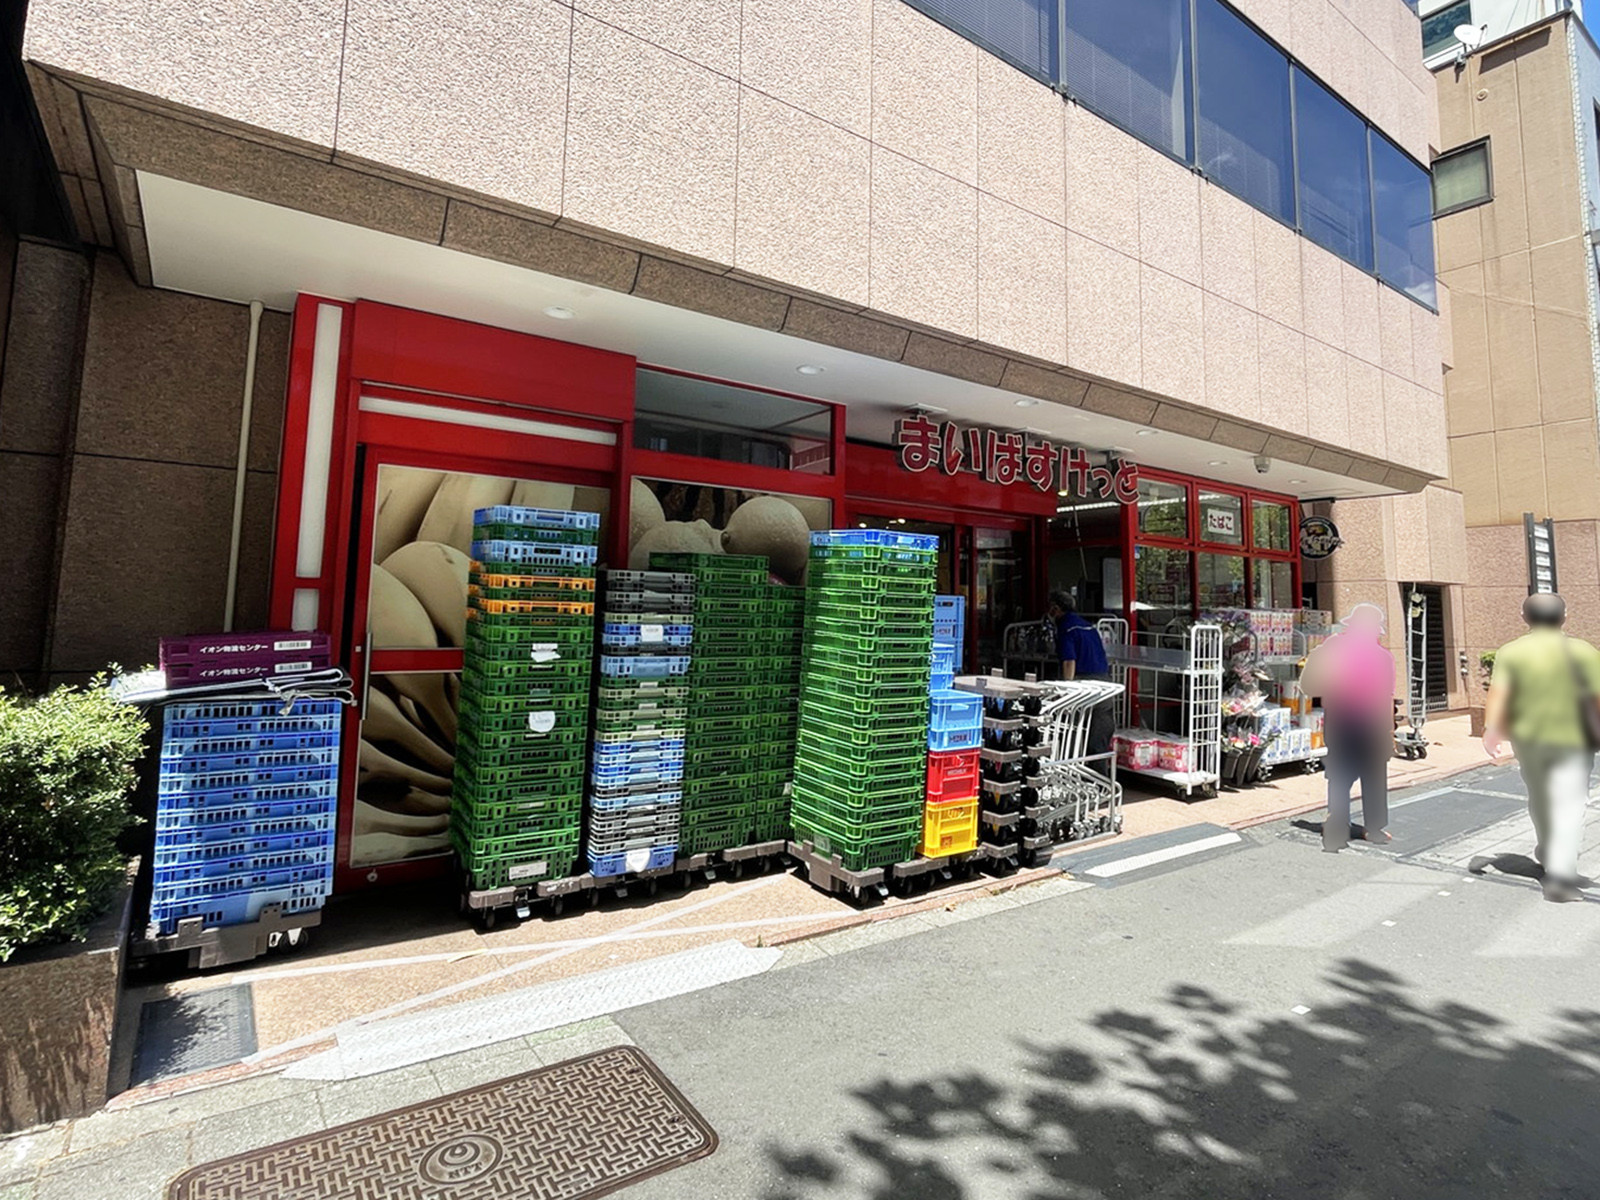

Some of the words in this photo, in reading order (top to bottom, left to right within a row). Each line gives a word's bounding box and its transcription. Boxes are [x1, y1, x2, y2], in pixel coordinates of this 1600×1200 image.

[896, 414, 1141, 505] まいばすけっと
[1208, 514, 1233, 530] たばこ
[199, 644, 269, 654] イオン物流センター
[199, 666, 269, 677] イオン物流センター
[448, 1162, 482, 1179] NTT
